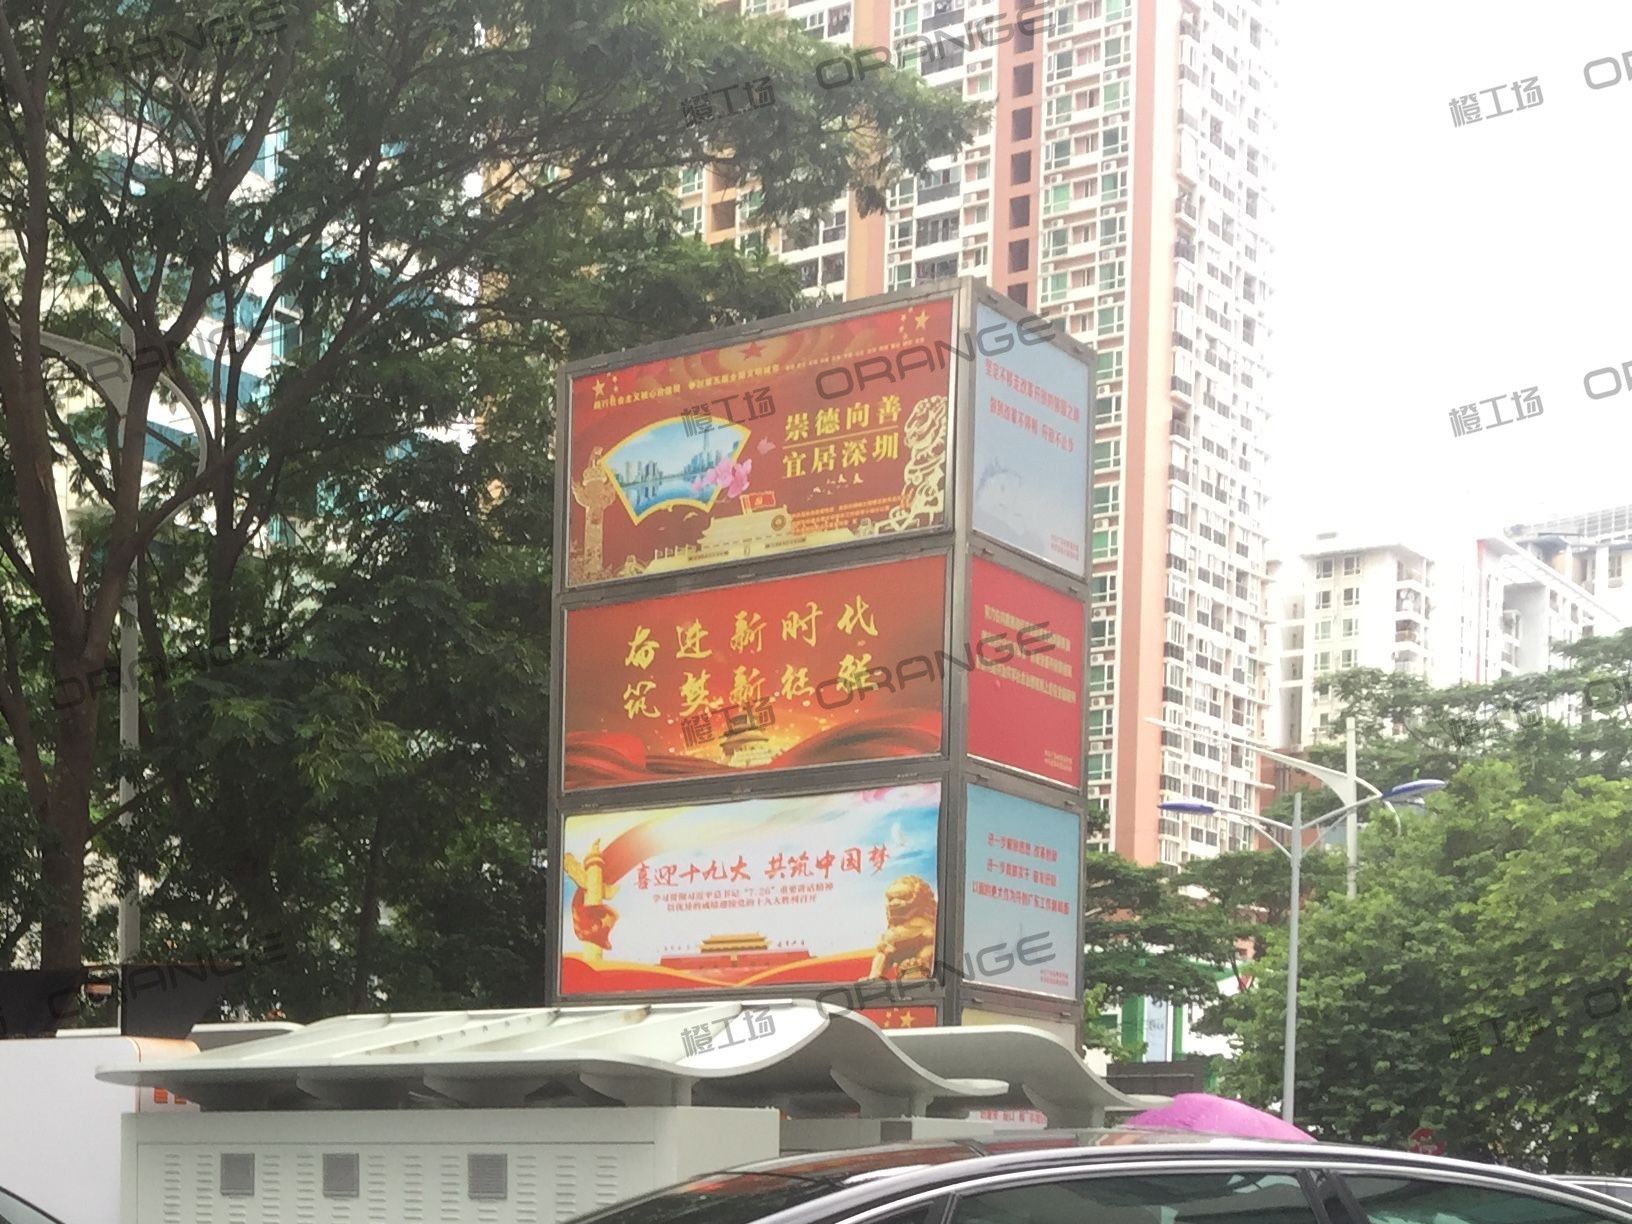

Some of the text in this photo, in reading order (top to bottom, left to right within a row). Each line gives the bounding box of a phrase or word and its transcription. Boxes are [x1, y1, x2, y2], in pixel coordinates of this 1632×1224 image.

[785, 395, 901, 441] 崇德向善
[782, 432, 899, 478] 宜居深圳
[624, 595, 879, 670] 奋进新时代
[634, 844, 890, 890] 喜迎十九大 共筑中国梦
